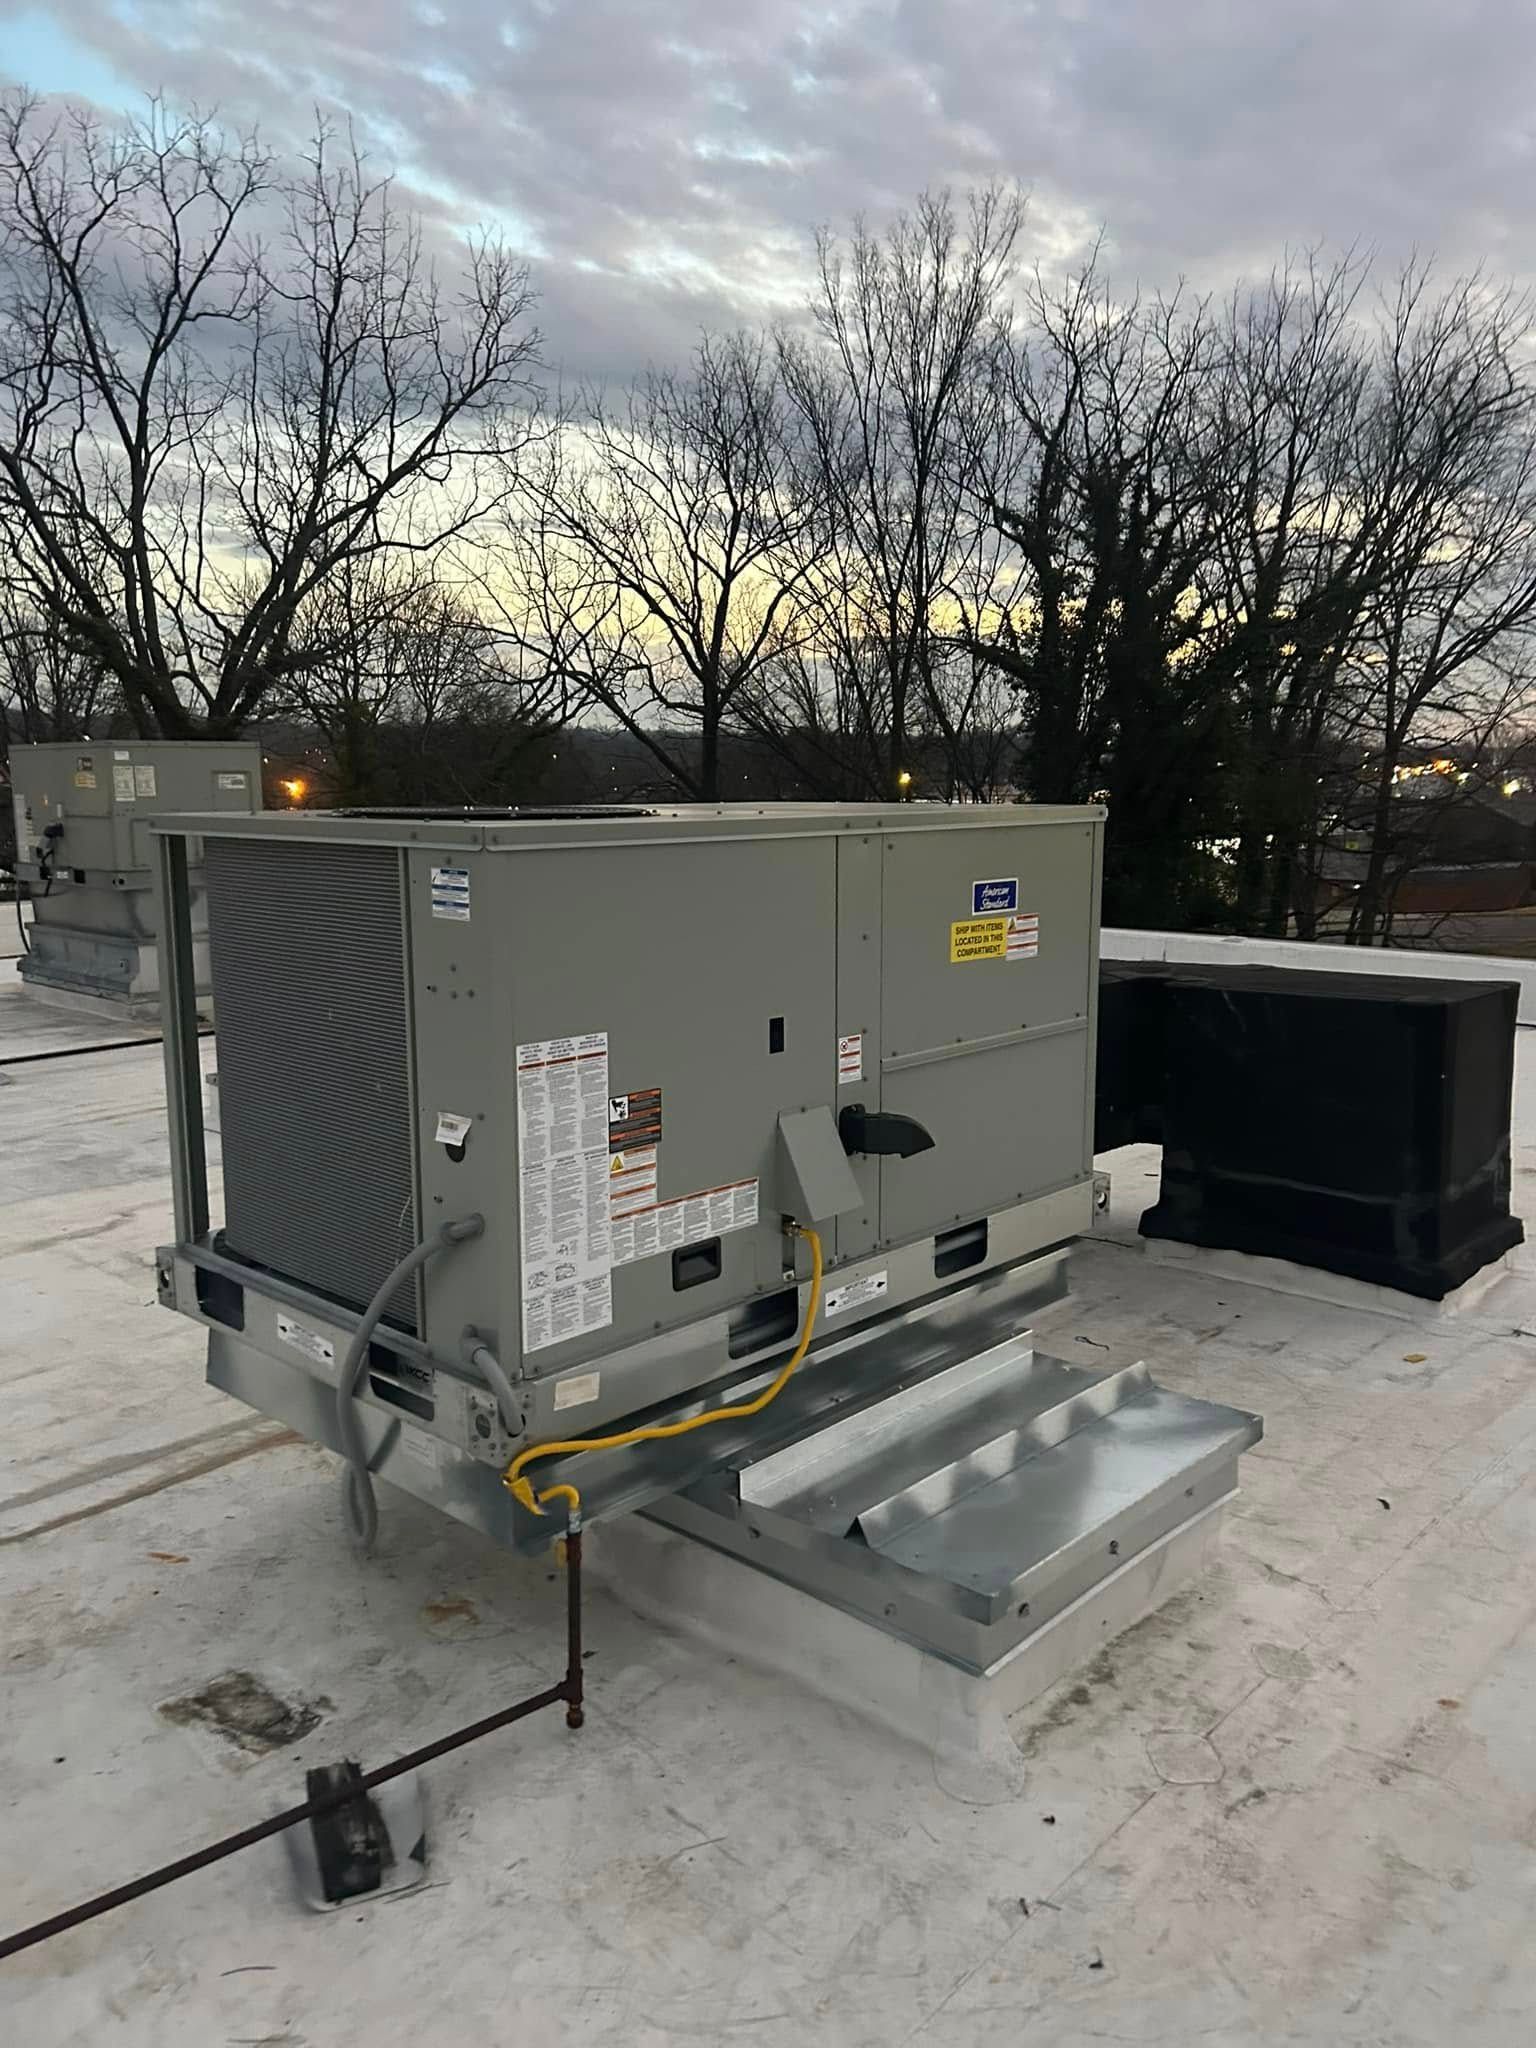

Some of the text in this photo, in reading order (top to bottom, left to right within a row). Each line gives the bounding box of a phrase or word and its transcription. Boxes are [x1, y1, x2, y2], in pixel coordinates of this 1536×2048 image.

[956, 922, 1003, 935] SHIP WITH ITEMS
[955, 933, 1003, 946] LOCATED IN THIS
[957, 944, 1001, 957] COMPARTMENT
